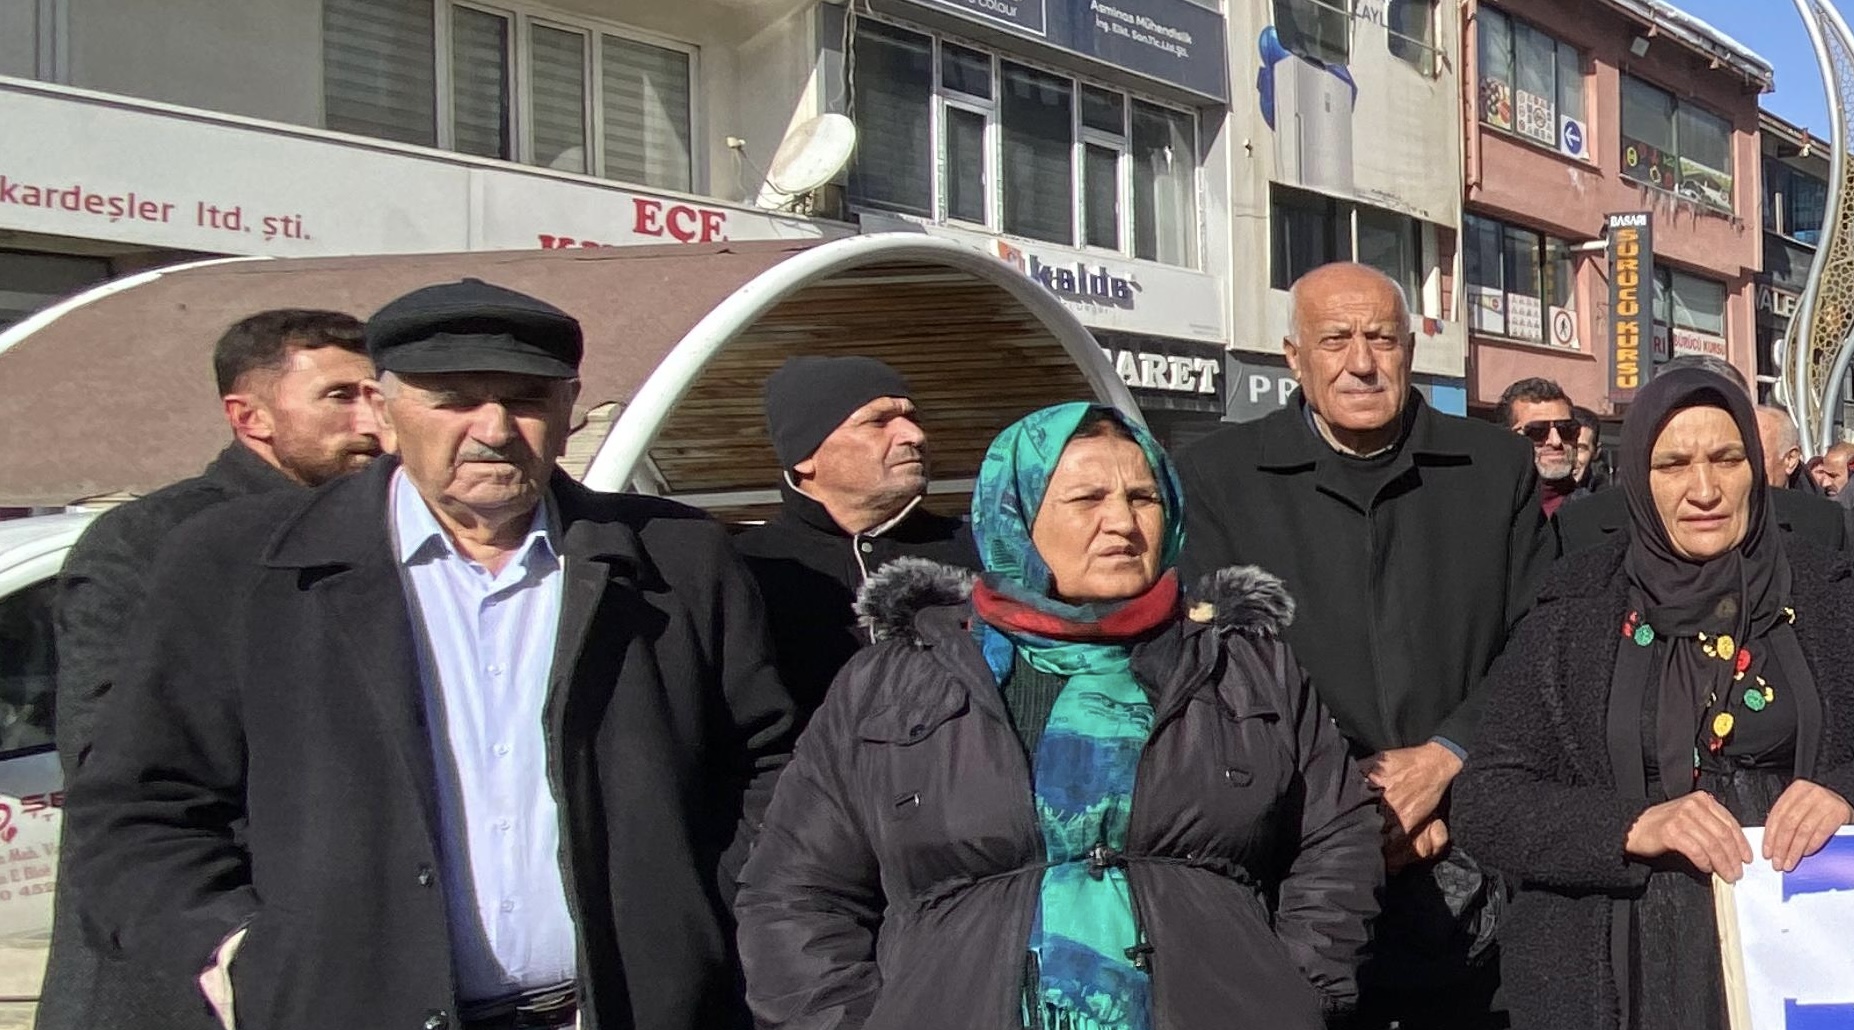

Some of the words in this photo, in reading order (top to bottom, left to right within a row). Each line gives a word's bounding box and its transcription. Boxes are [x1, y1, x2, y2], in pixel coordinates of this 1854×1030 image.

[0, 175, 175, 223] kardeşler
[197, 201, 251, 232] ltd.
[262, 214, 311, 242] şti.
